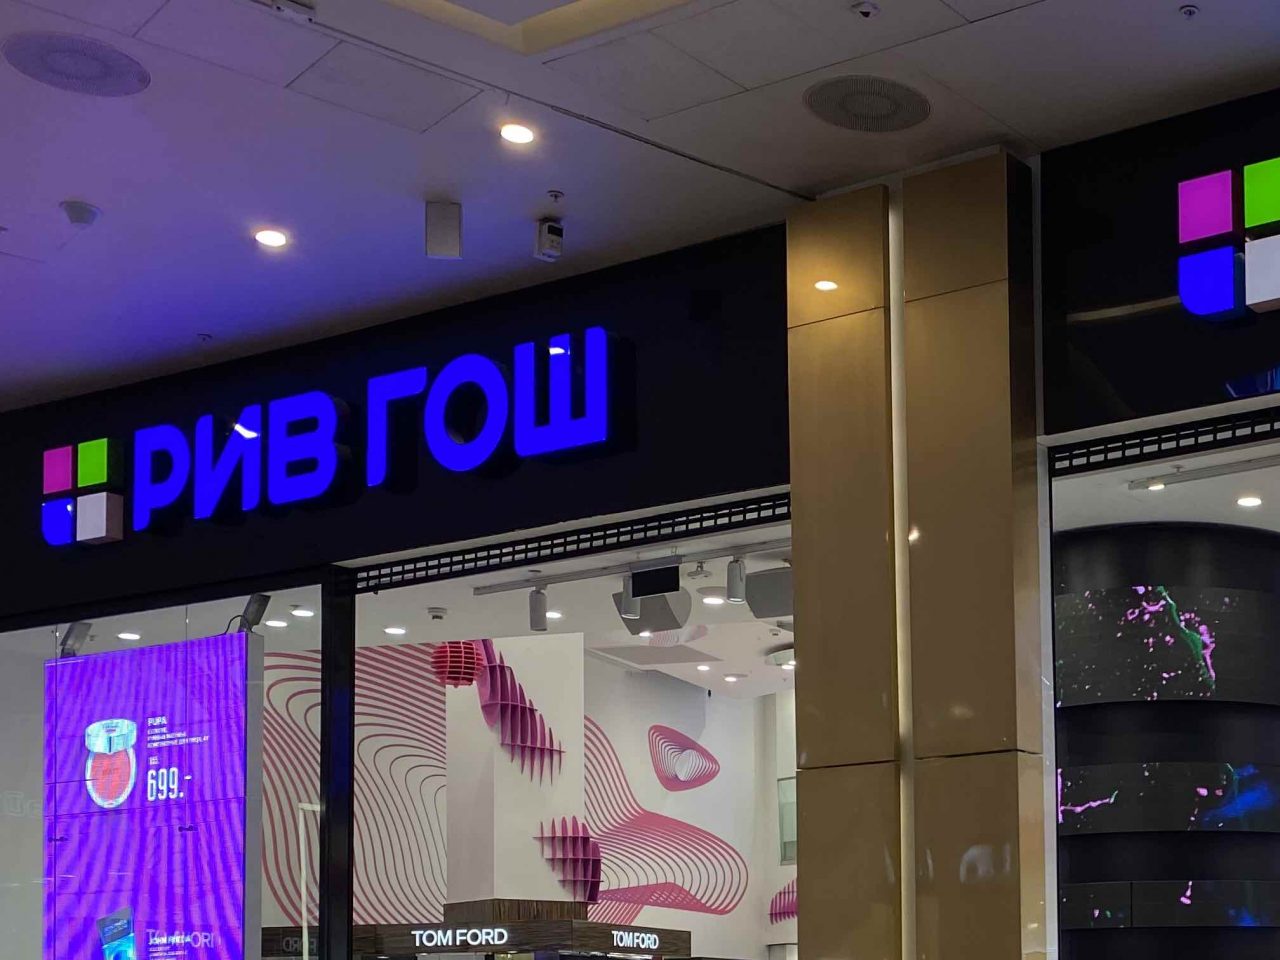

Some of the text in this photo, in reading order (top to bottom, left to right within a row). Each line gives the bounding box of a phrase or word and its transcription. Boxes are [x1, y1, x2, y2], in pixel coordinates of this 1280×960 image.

[133, 326, 609, 532] РИВ ГОШ
[147, 716, 169, 727] PUPA
[410, 928, 508, 947] TOM FORD
[612, 931, 659, 950] TOM FORD
